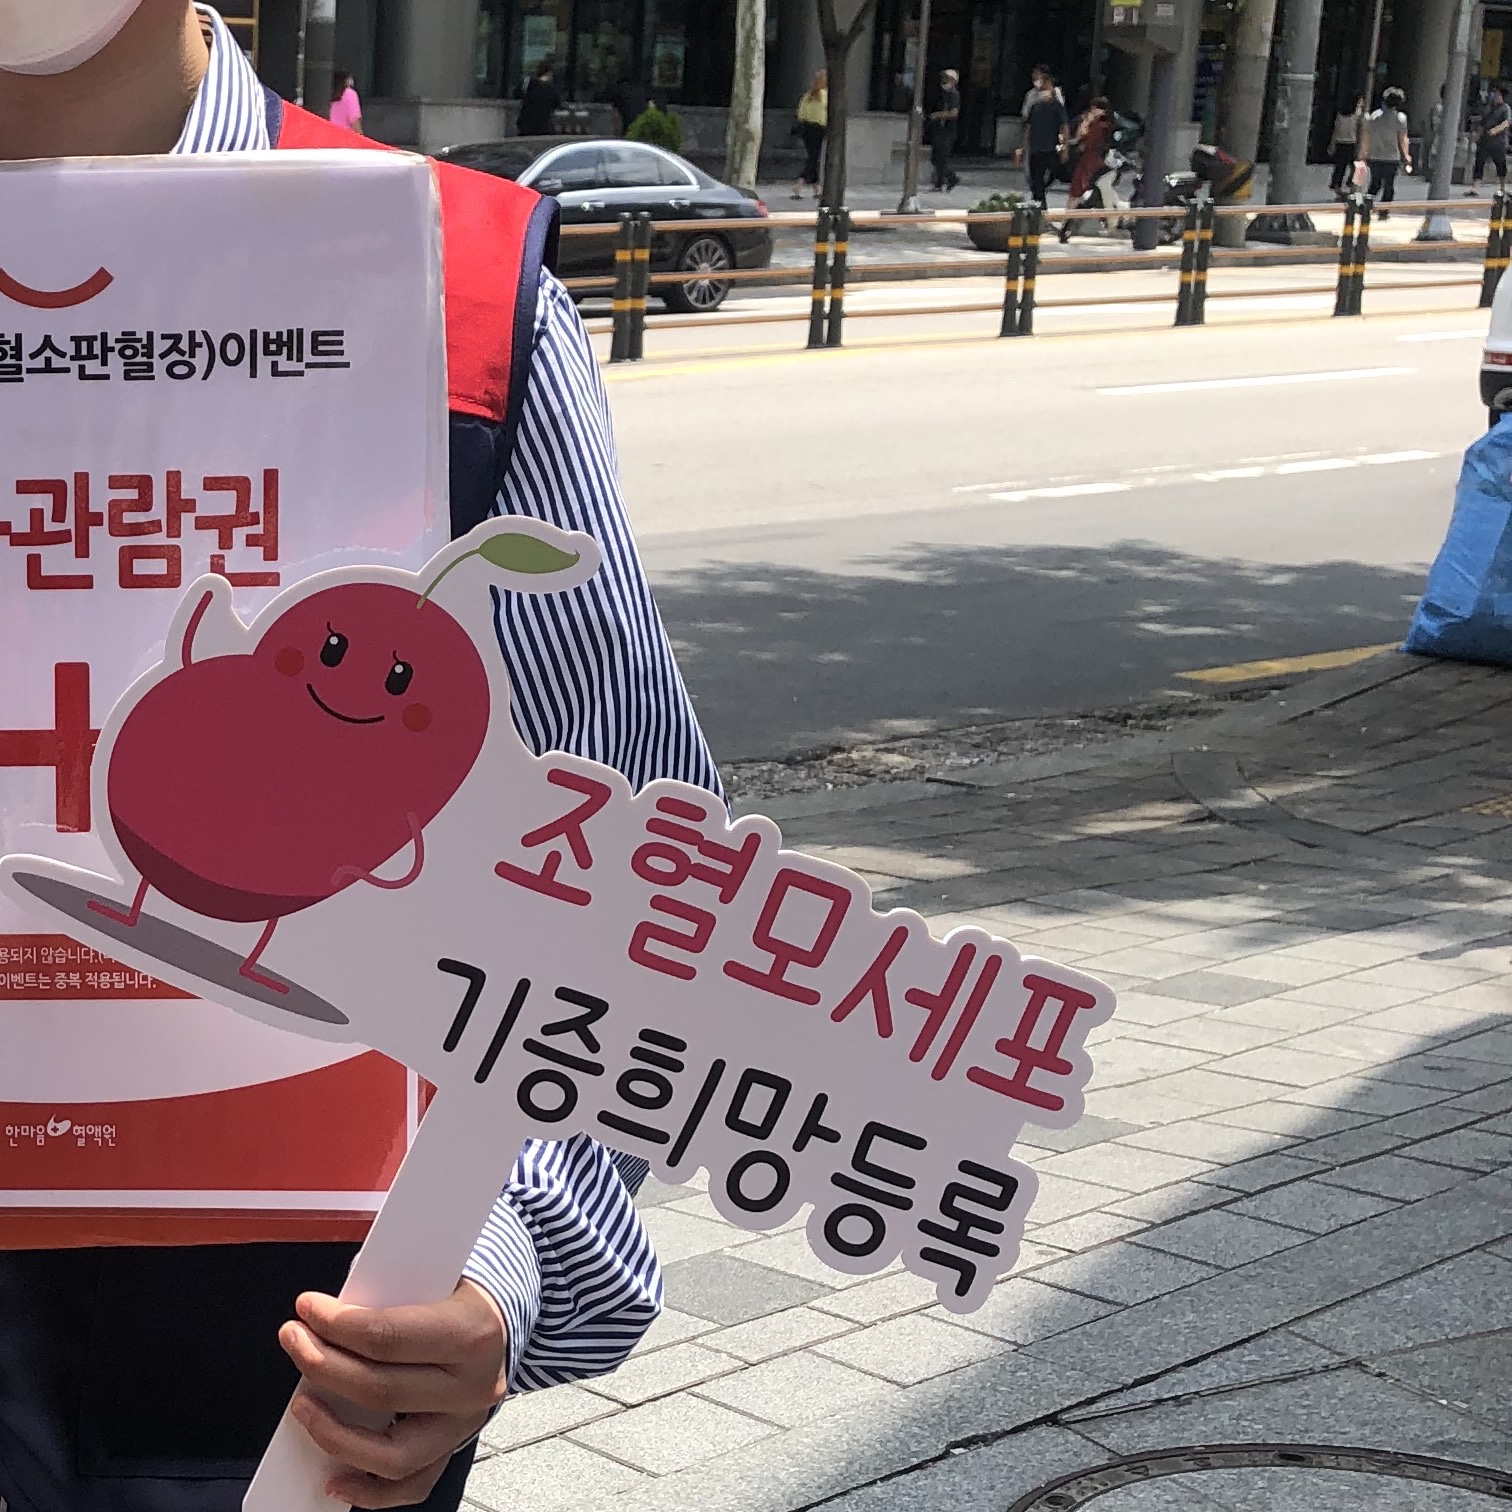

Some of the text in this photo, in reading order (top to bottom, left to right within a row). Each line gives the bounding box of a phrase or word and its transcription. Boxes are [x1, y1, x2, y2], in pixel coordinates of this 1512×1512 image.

[54, 972, 81, 989] 중복
[85, 971, 157, 989] 적용됩니다.
[494, 768, 1097, 1111] 조혈모세포
[5, 1124, 116, 1147] 한마음 혈액원
[437, 958, 1020, 1297] 기증희망등록
